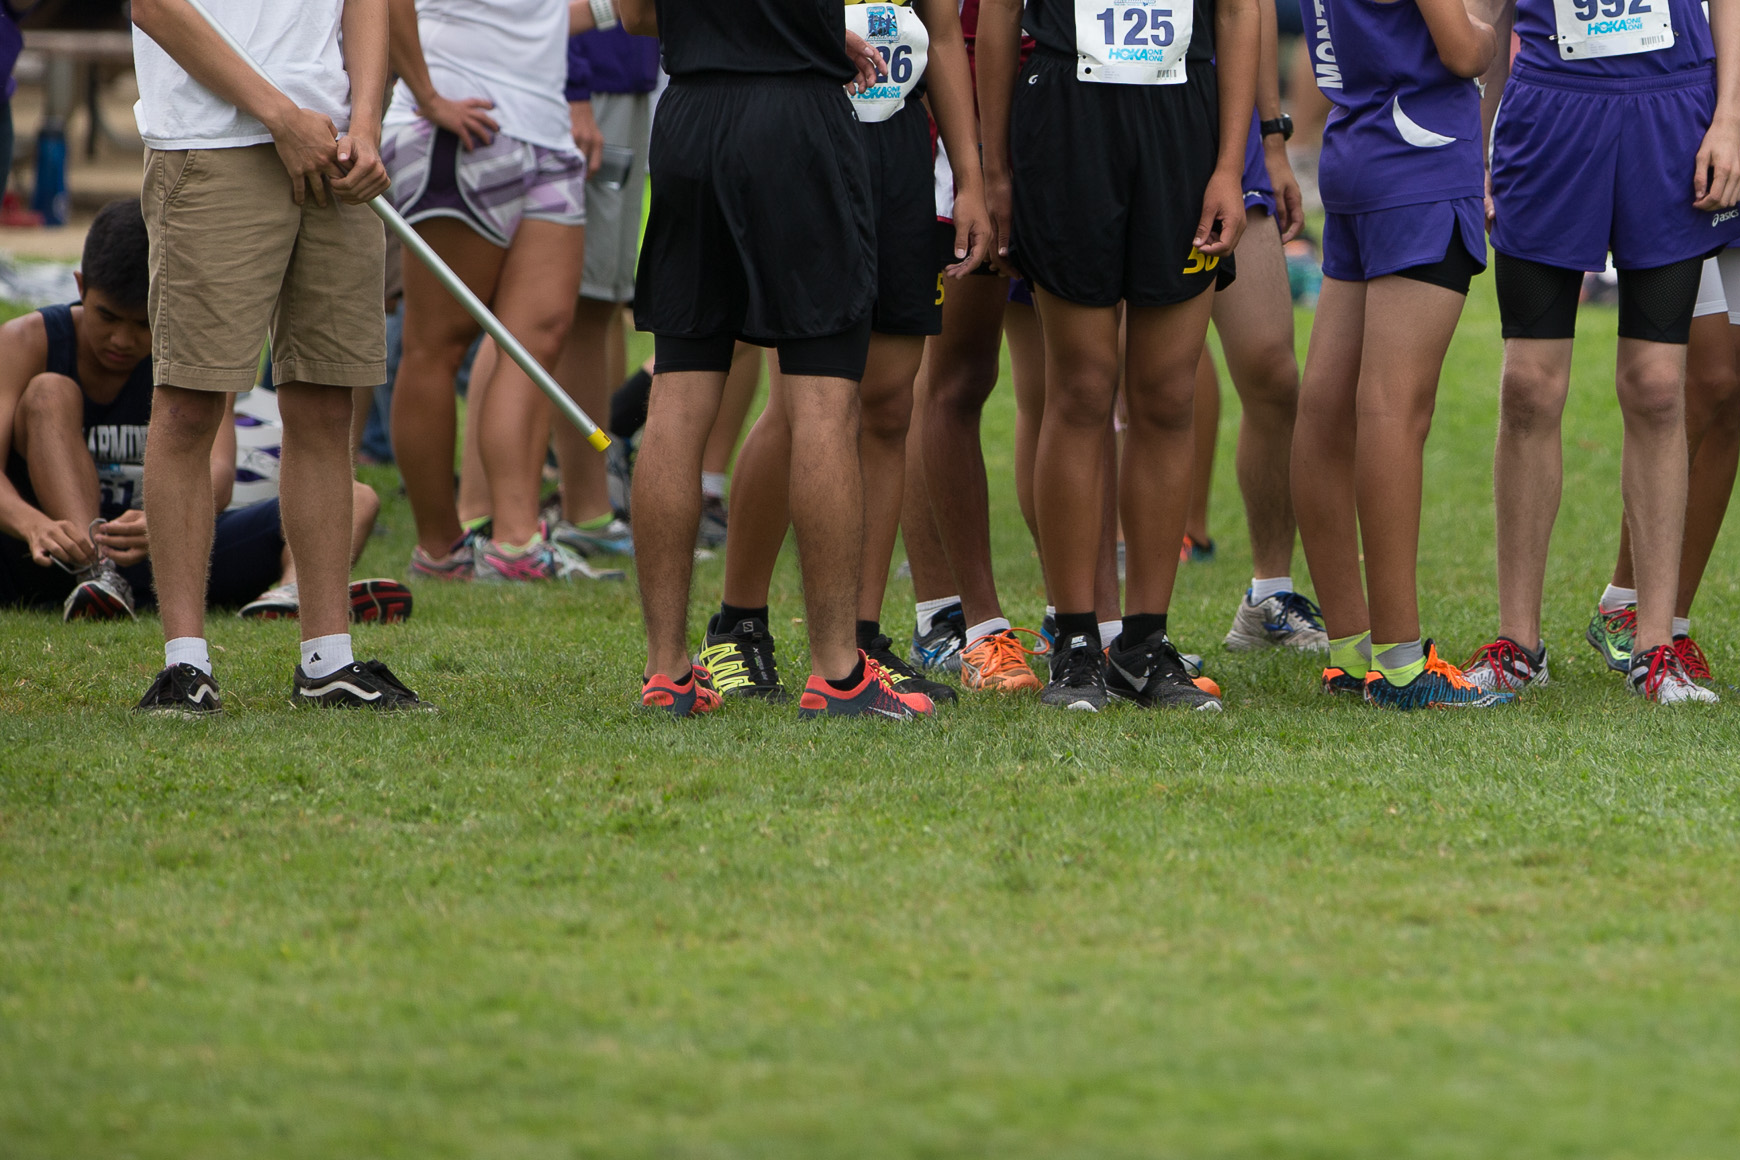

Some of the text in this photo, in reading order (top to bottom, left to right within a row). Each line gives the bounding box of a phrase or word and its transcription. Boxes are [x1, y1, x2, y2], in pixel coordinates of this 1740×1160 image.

[1097, 8, 1174, 47] 125
[1587, 19, 1627, 35] HOKA
[871, 44, 913, 84] 26
[1109, 48, 1148, 61] HOKA
